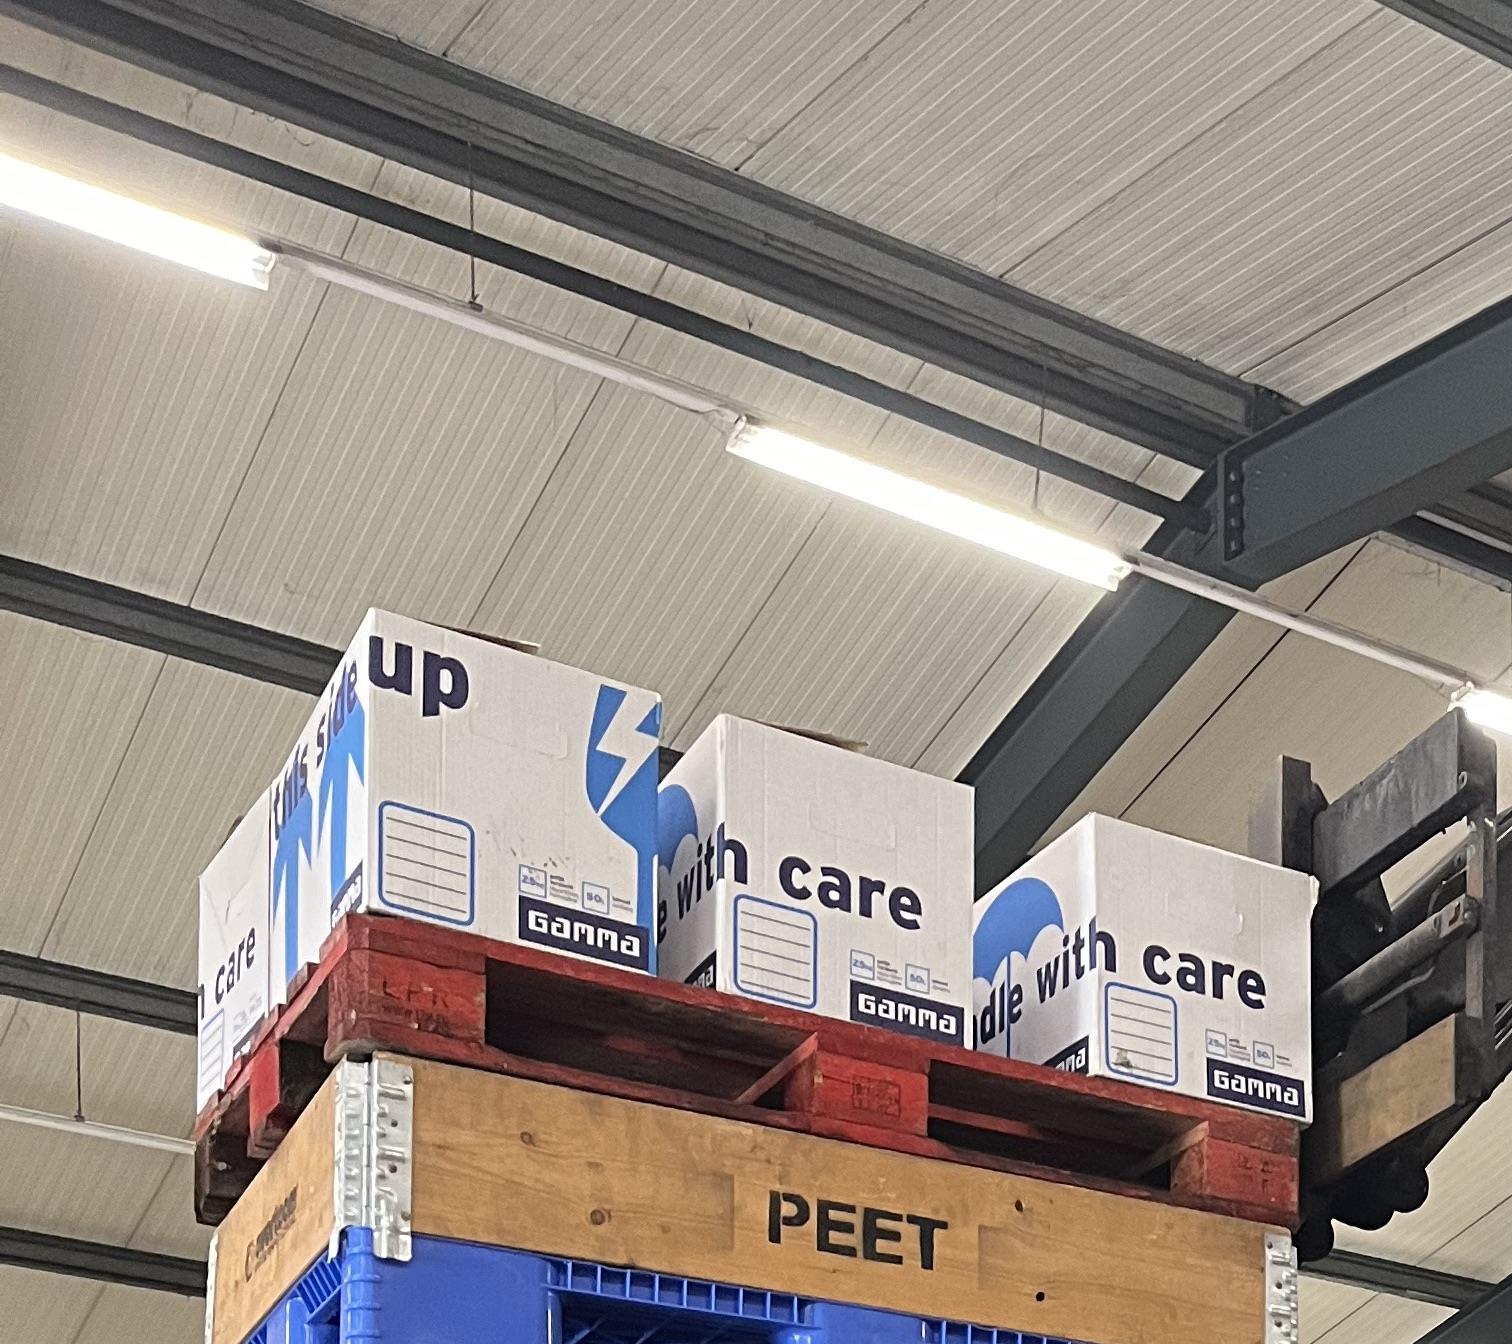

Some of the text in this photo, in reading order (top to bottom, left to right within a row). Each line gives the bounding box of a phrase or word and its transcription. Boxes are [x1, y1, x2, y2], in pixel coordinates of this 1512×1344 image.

[368, 635, 469, 717] up
[677, 822, 923, 931] with care
[215, 927, 256, 1004] care
[1037, 915, 1117, 1004] with
[1143, 945, 1267, 1009] care
[768, 1189, 948, 1271] PEET
